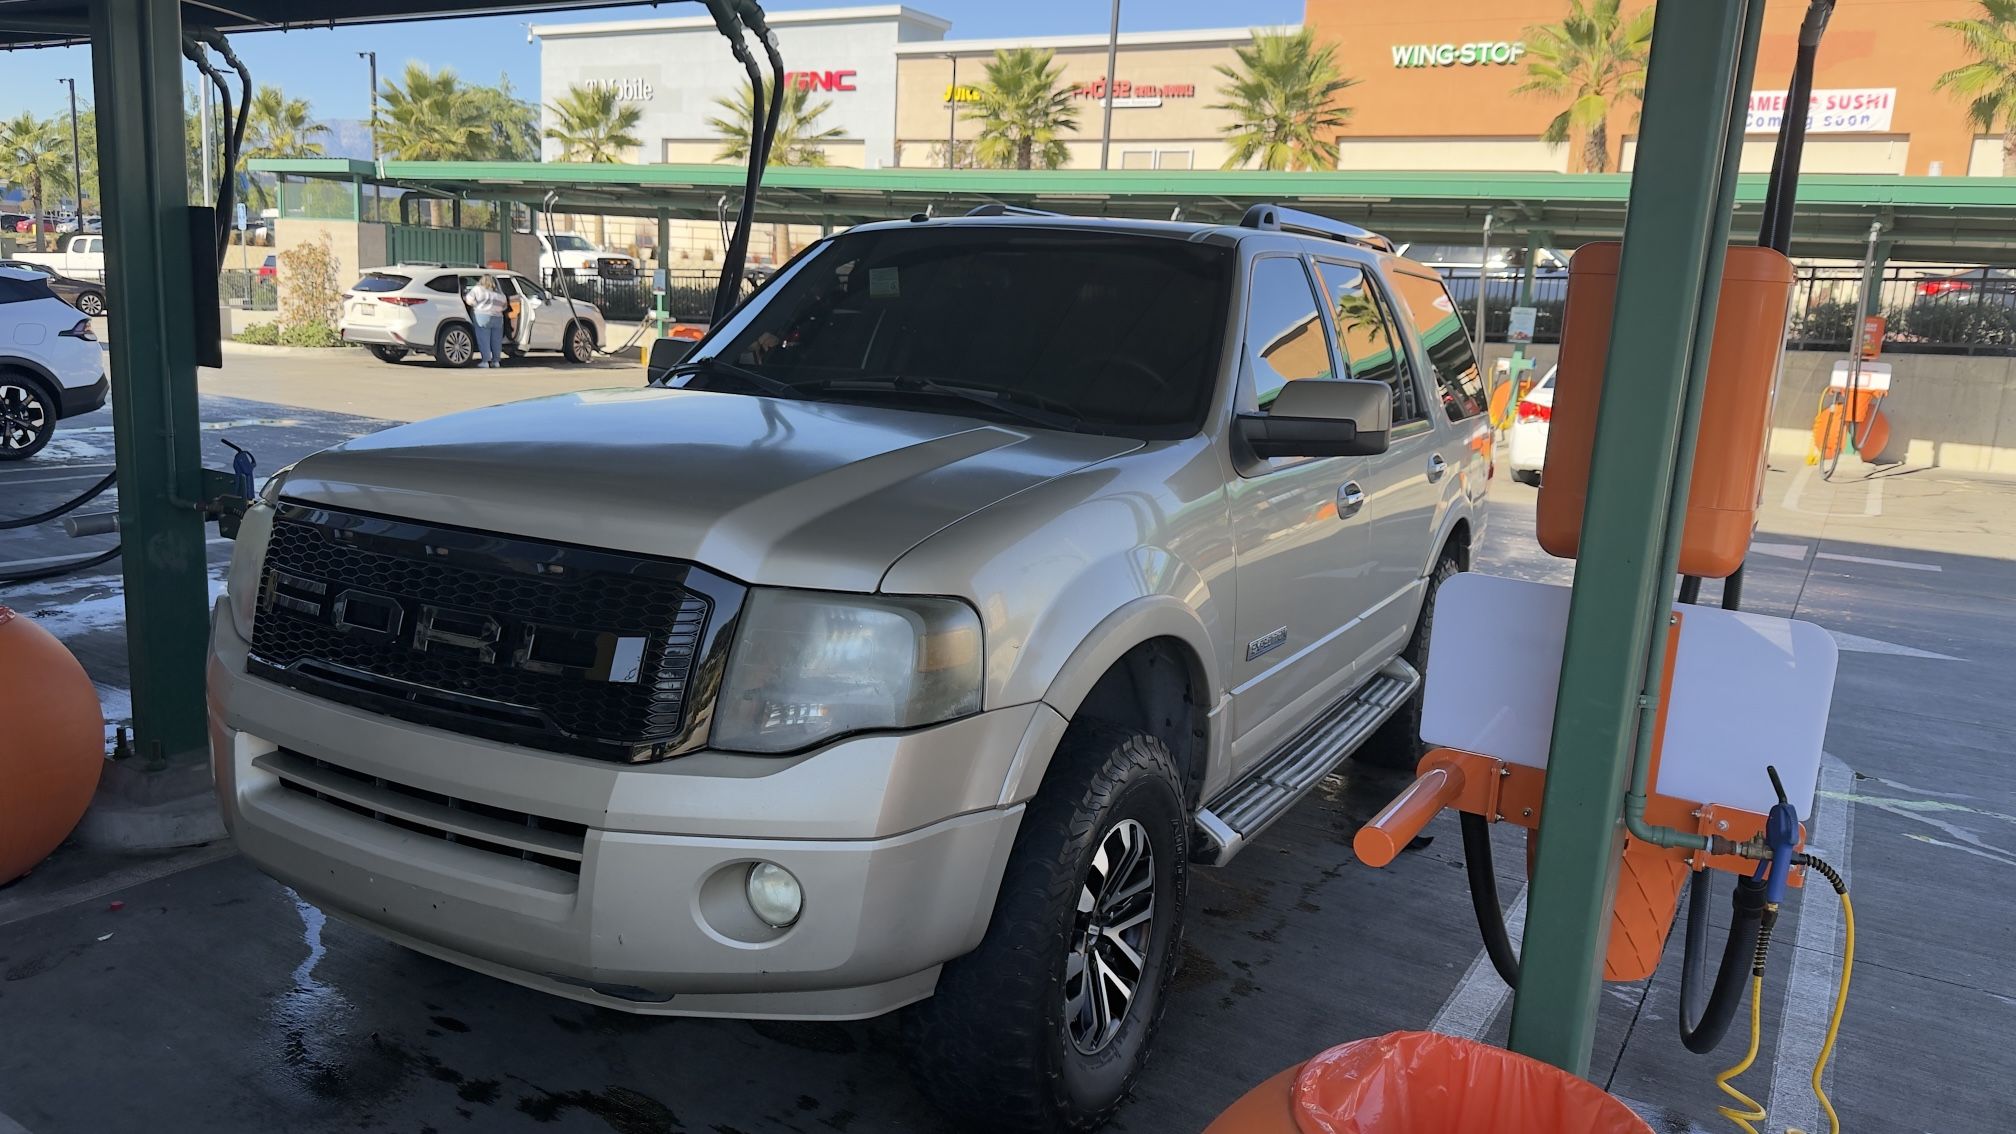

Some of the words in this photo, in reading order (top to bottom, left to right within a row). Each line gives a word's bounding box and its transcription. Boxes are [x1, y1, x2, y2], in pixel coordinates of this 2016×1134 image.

[784, 70, 857, 91] GNC
[1826, 94, 1888, 111] SUSHI
[1746, 114, 1813, 129] Comg
[1823, 115, 1870, 127] soon
